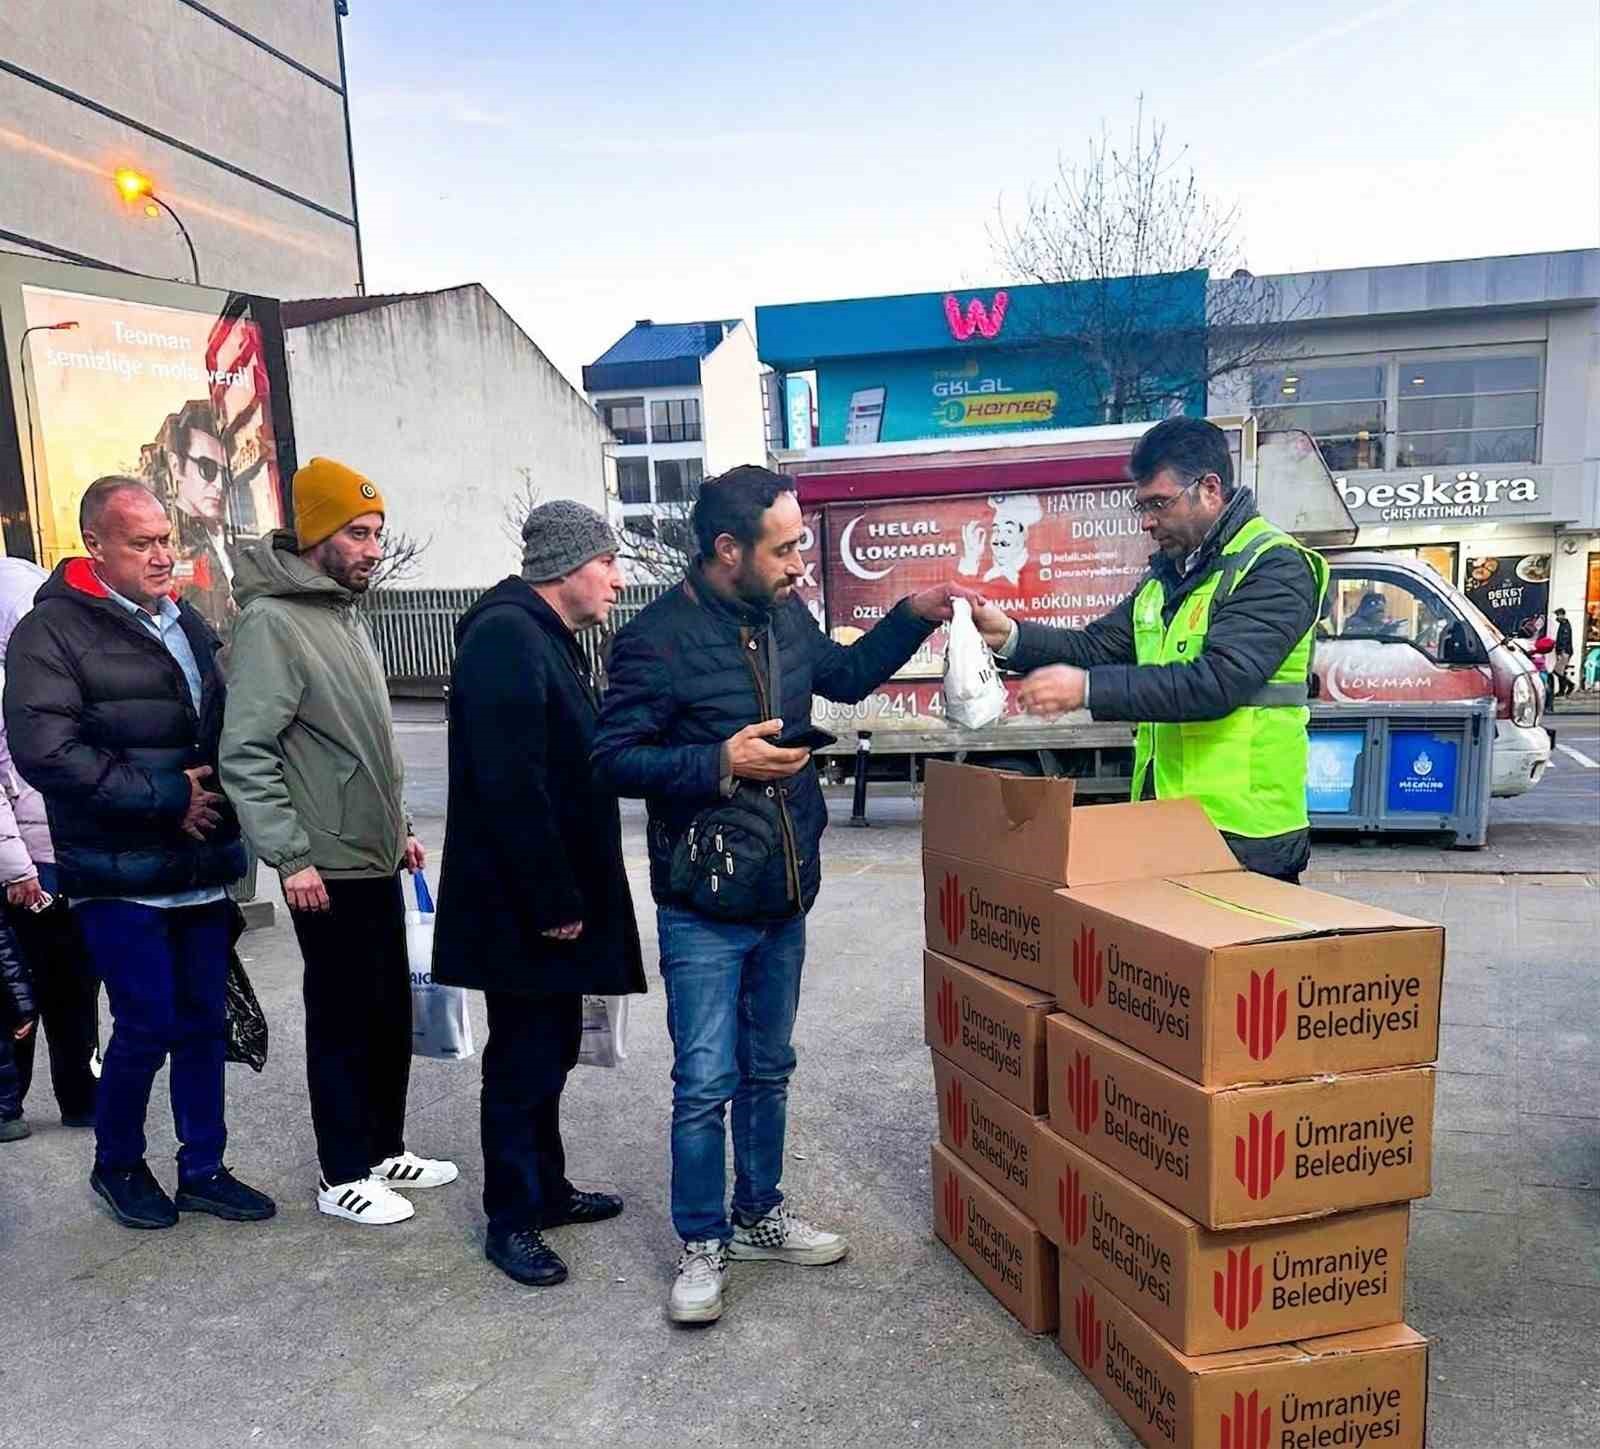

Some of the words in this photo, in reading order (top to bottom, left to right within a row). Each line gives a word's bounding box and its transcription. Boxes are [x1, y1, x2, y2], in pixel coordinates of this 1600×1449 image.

[112, 320, 191, 349] Teoman
[945, 291, 1008, 340] W
[1101, 489, 1138, 508] LOK
[1335, 471, 1539, 509] beskära
[868, 521, 941, 537] HELAL
[855, 543, 957, 561] LOKMAM
[853, 605, 886, 619] ÖZEL
[1341, 676, 1432, 689] LOKMAM
[879, 692, 921, 721] 241
[969, 887, 1041, 935] Ümraniye
[970, 919, 1041, 964] Belediyesi
[1107, 943, 1191, 1009] Ümraniye
[1297, 974, 1420, 1009] Ümraniye
[962, 996, 1021, 1050] Ümraniye
[1108, 981, 1190, 1041] Belediyesi
[1296, 1003, 1419, 1041] Belediyesi
[962, 1027, 1021, 1079] Belediyesi
[971, 1098, 1028, 1162] Ümraniye
[1105, 1074, 1190, 1147] Ümraniye
[1295, 1112, 1414, 1149] Ümraniye
[971, 1128, 1029, 1190] Belediyesi
[1104, 1114, 1190, 1181] Belediyesi
[1295, 1140, 1413, 1180] Belediyesi
[967, 1195, 1023, 1266] Ümraniye
[1091, 1191, 1171, 1273] Ümraniye
[967, 1227, 1023, 1294] Belediyesi
[1091, 1227, 1171, 1306] Belediyesi
[1272, 1246, 1388, 1281] Ümraniye
[1272, 1270, 1388, 1311] Belediyesi
[1106, 1319, 1176, 1413] Ümraniye
[1106, 1353, 1176, 1444] Belediyesi
[1281, 1387, 1401, 1424] Ümraniye
[1281, 1412, 1400, 1449] Belediyesi
